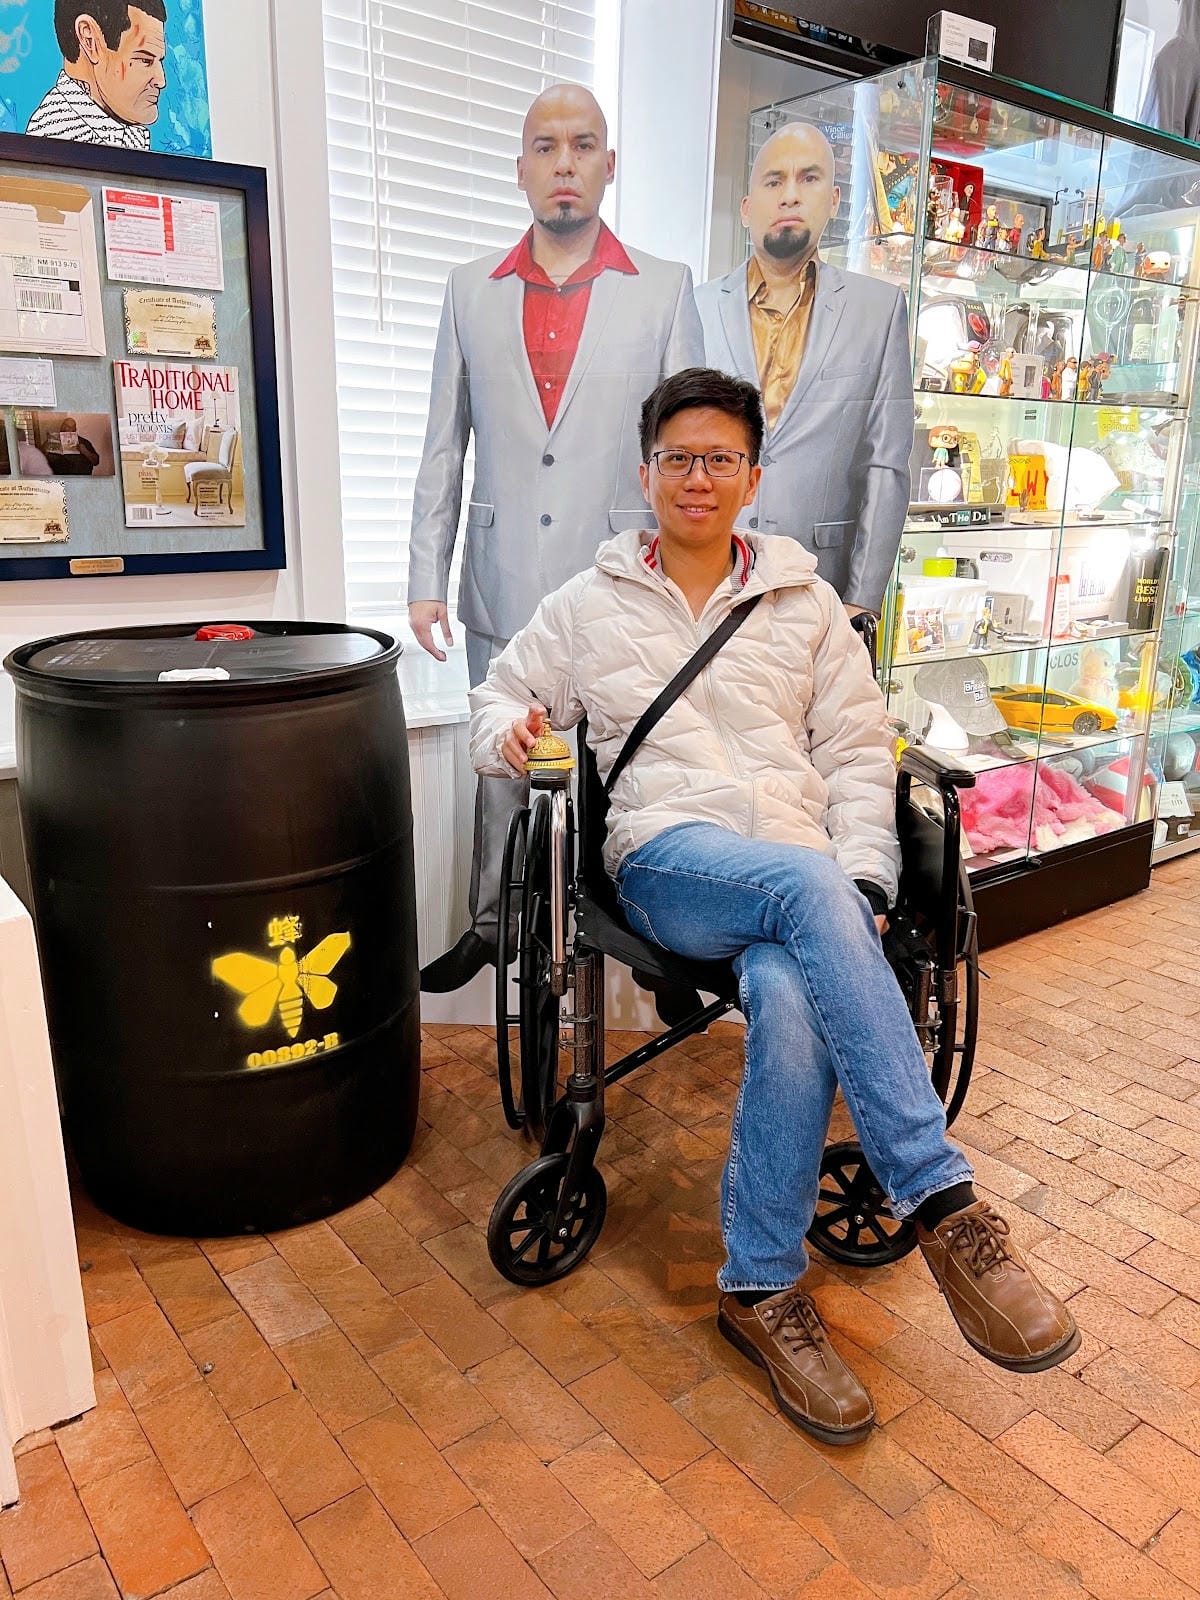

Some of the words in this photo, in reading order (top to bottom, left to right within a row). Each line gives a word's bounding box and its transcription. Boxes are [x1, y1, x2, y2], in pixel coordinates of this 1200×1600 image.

[824, 125, 845, 134] Vince
[115, 361, 235, 393] TRADITIONAL
[153, 389, 205, 411] HOME
[128, 411, 169, 426] pretty
